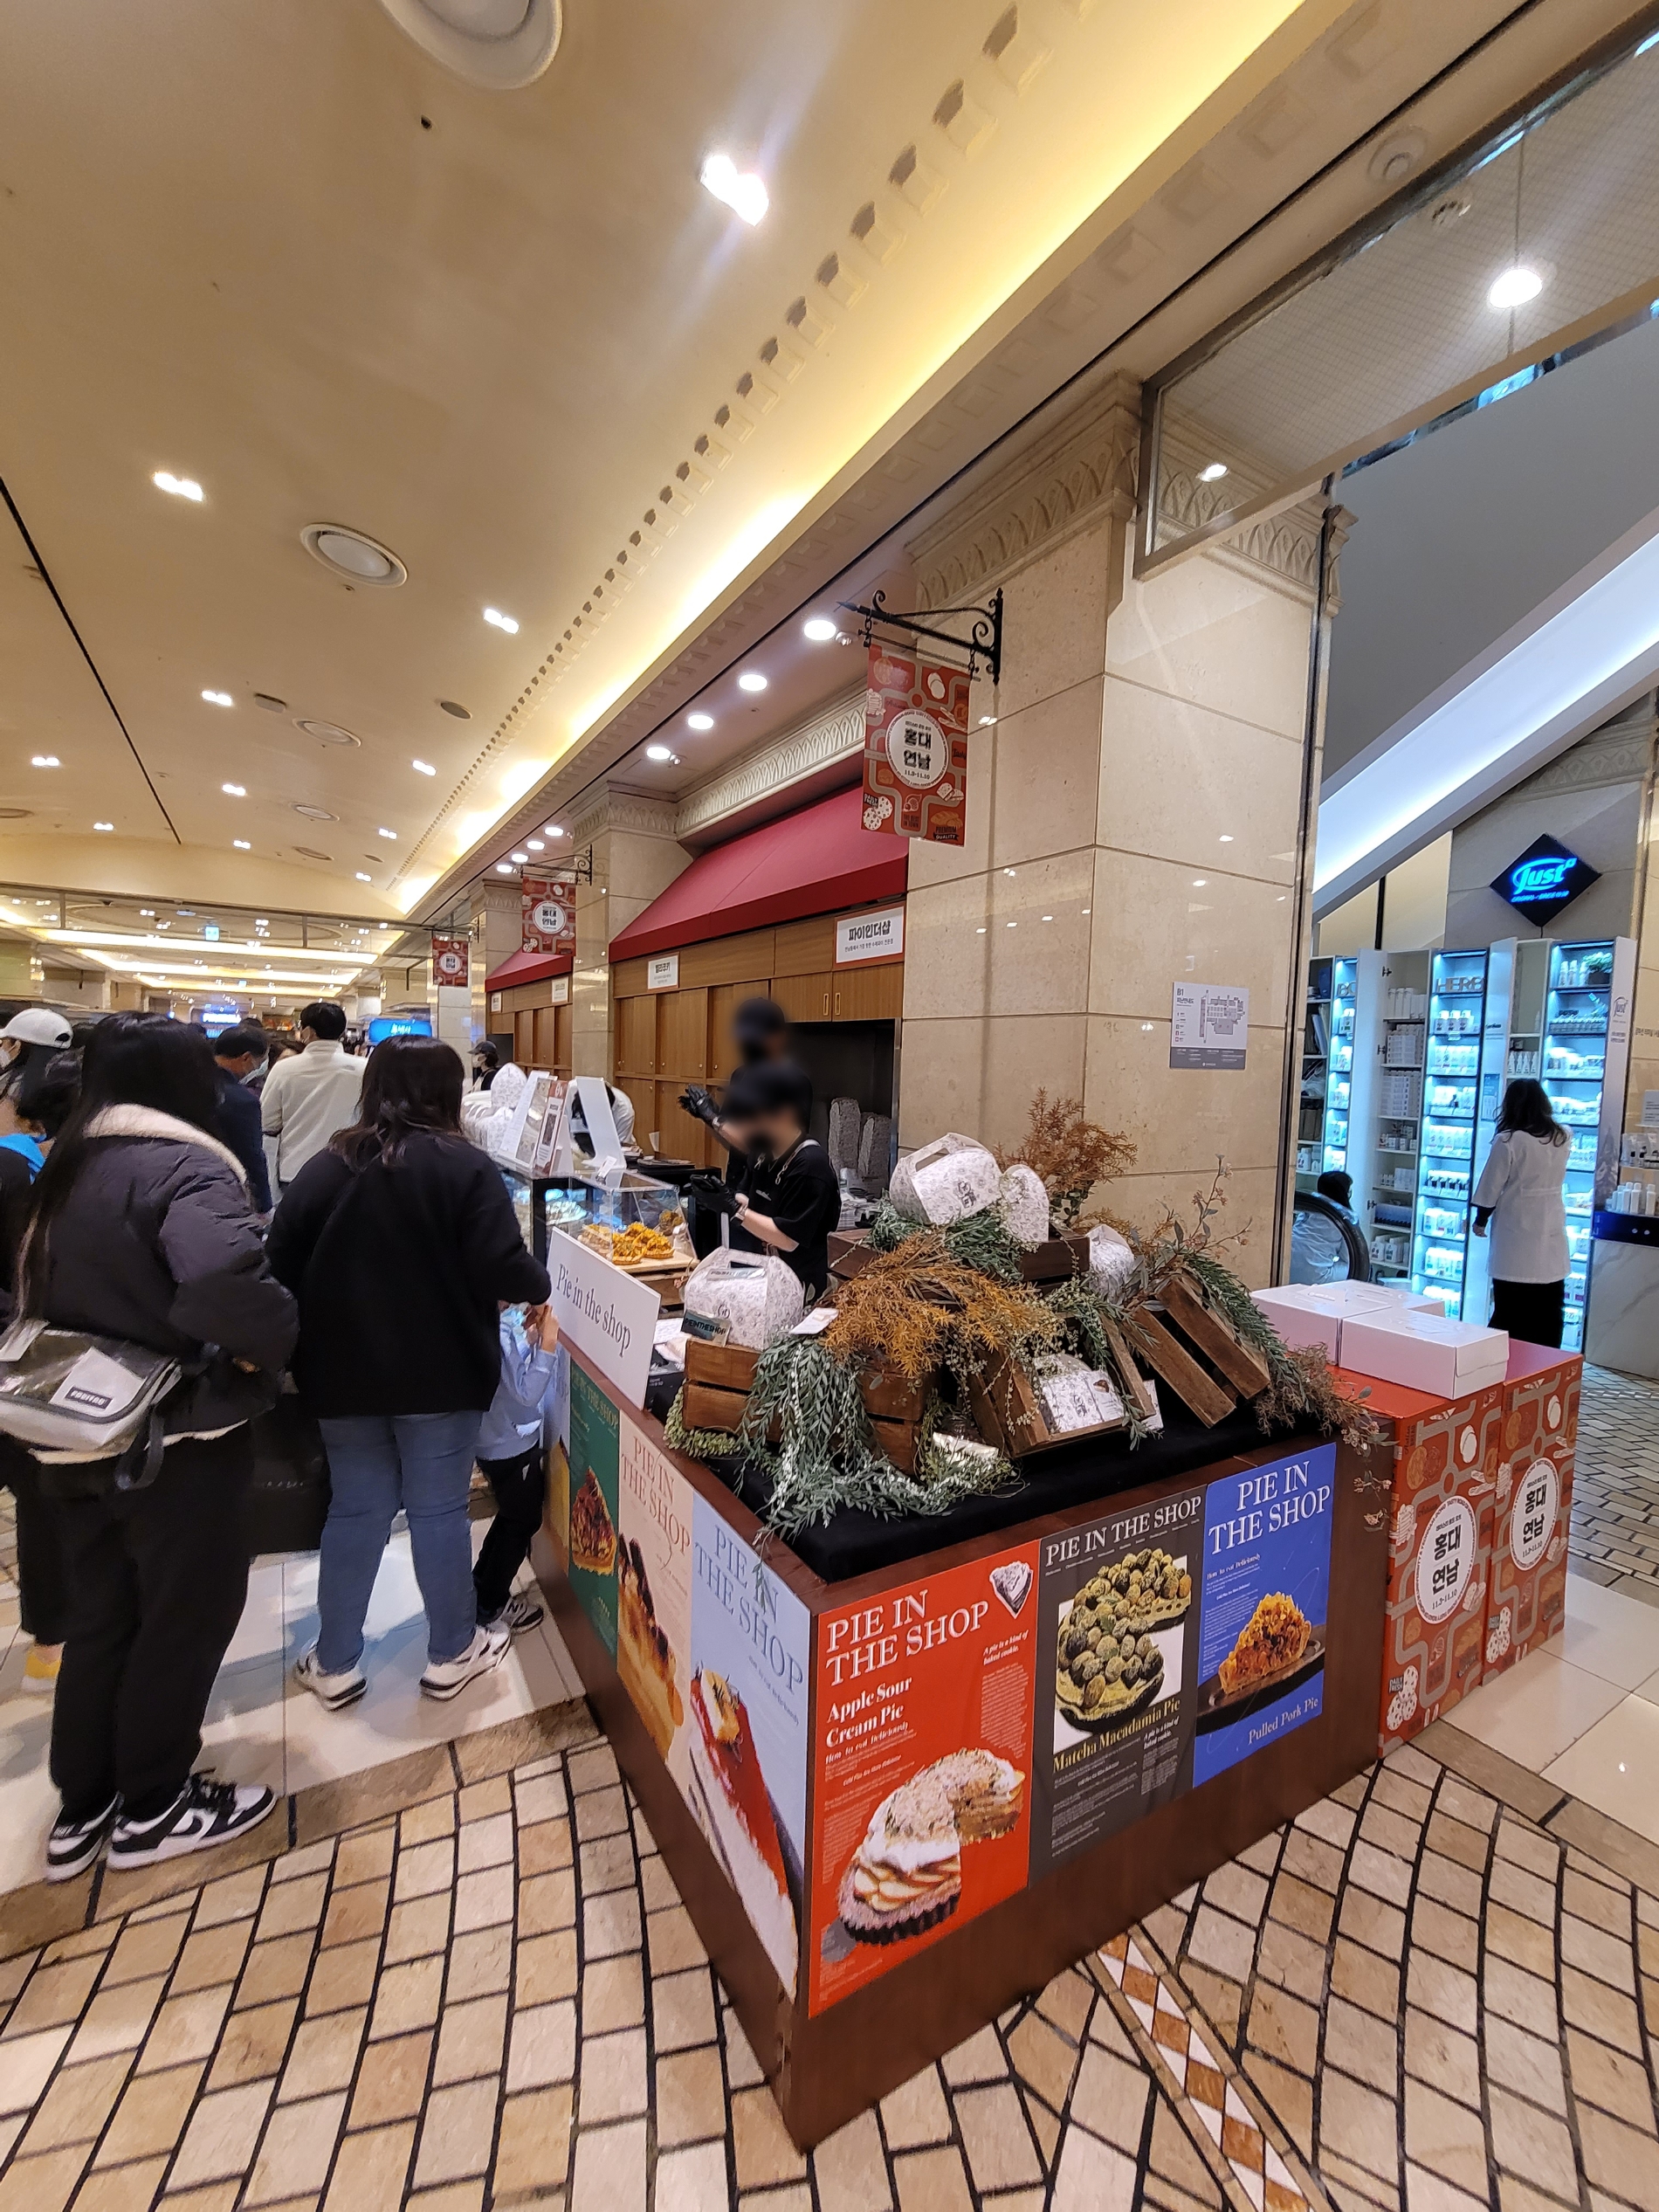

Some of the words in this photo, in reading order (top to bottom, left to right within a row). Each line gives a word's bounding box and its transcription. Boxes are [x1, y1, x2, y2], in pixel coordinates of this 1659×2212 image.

[1513, 860, 1573, 895] Just
[556, 1263, 572, 1299] Pie
[572, 1277, 583, 1309] in
[584, 1288, 602, 1324] the
[602, 1303, 631, 1358] shop
[621, 1453, 646, 1506] THE
[649, 1488, 691, 1556] SHOP
[633, 1437, 655, 1483] PIE
[658, 1464, 675, 1506] IN
[1236, 1471, 1278, 1512] PIE
[1283, 1460, 1310, 1495] IN
[1525, 1483, 1547, 1514] 홍대
[1045, 1535, 1080, 1568] PIE
[1084, 1526, 1107, 1554] IN
[1111, 1512, 1151, 1543] THE
[1153, 1495, 1201, 1528] SHOP
[1208, 1510, 1263, 1555] THE
[1269, 1485, 1331, 1533] SHOP
[1434, 1524, 1462, 1561] 홍대
[1523, 1513, 1545, 1545] 연남
[714, 1525, 747, 1589] PIE
[754, 1568, 779, 1623] IN
[1432, 1557, 1460, 1595] 연남
[694, 1541, 734, 1616] THE
[739, 1596, 803, 1695] SHOP
[825, 1634, 898, 1687] THE
[905, 1601, 989, 1657] SHOP
[826, 1604, 884, 1654] PIE
[891, 1588, 928, 1630] IN
[826, 1716, 878, 1747] Cream
[880, 1703, 904, 1726] Pie
[827, 1690, 874, 1724] Apple
[877, 1678, 912, 1703] Sour
[1248, 1716, 1278, 1745] Pulled
[1280, 1704, 1301, 1726] Pork
[1304, 1697, 1318, 1712] Pie
[1053, 1740, 1097, 1773] Matcha
[1099, 1707, 1161, 1750] Macadamia
[1164, 1697, 1181, 1717] Pie
